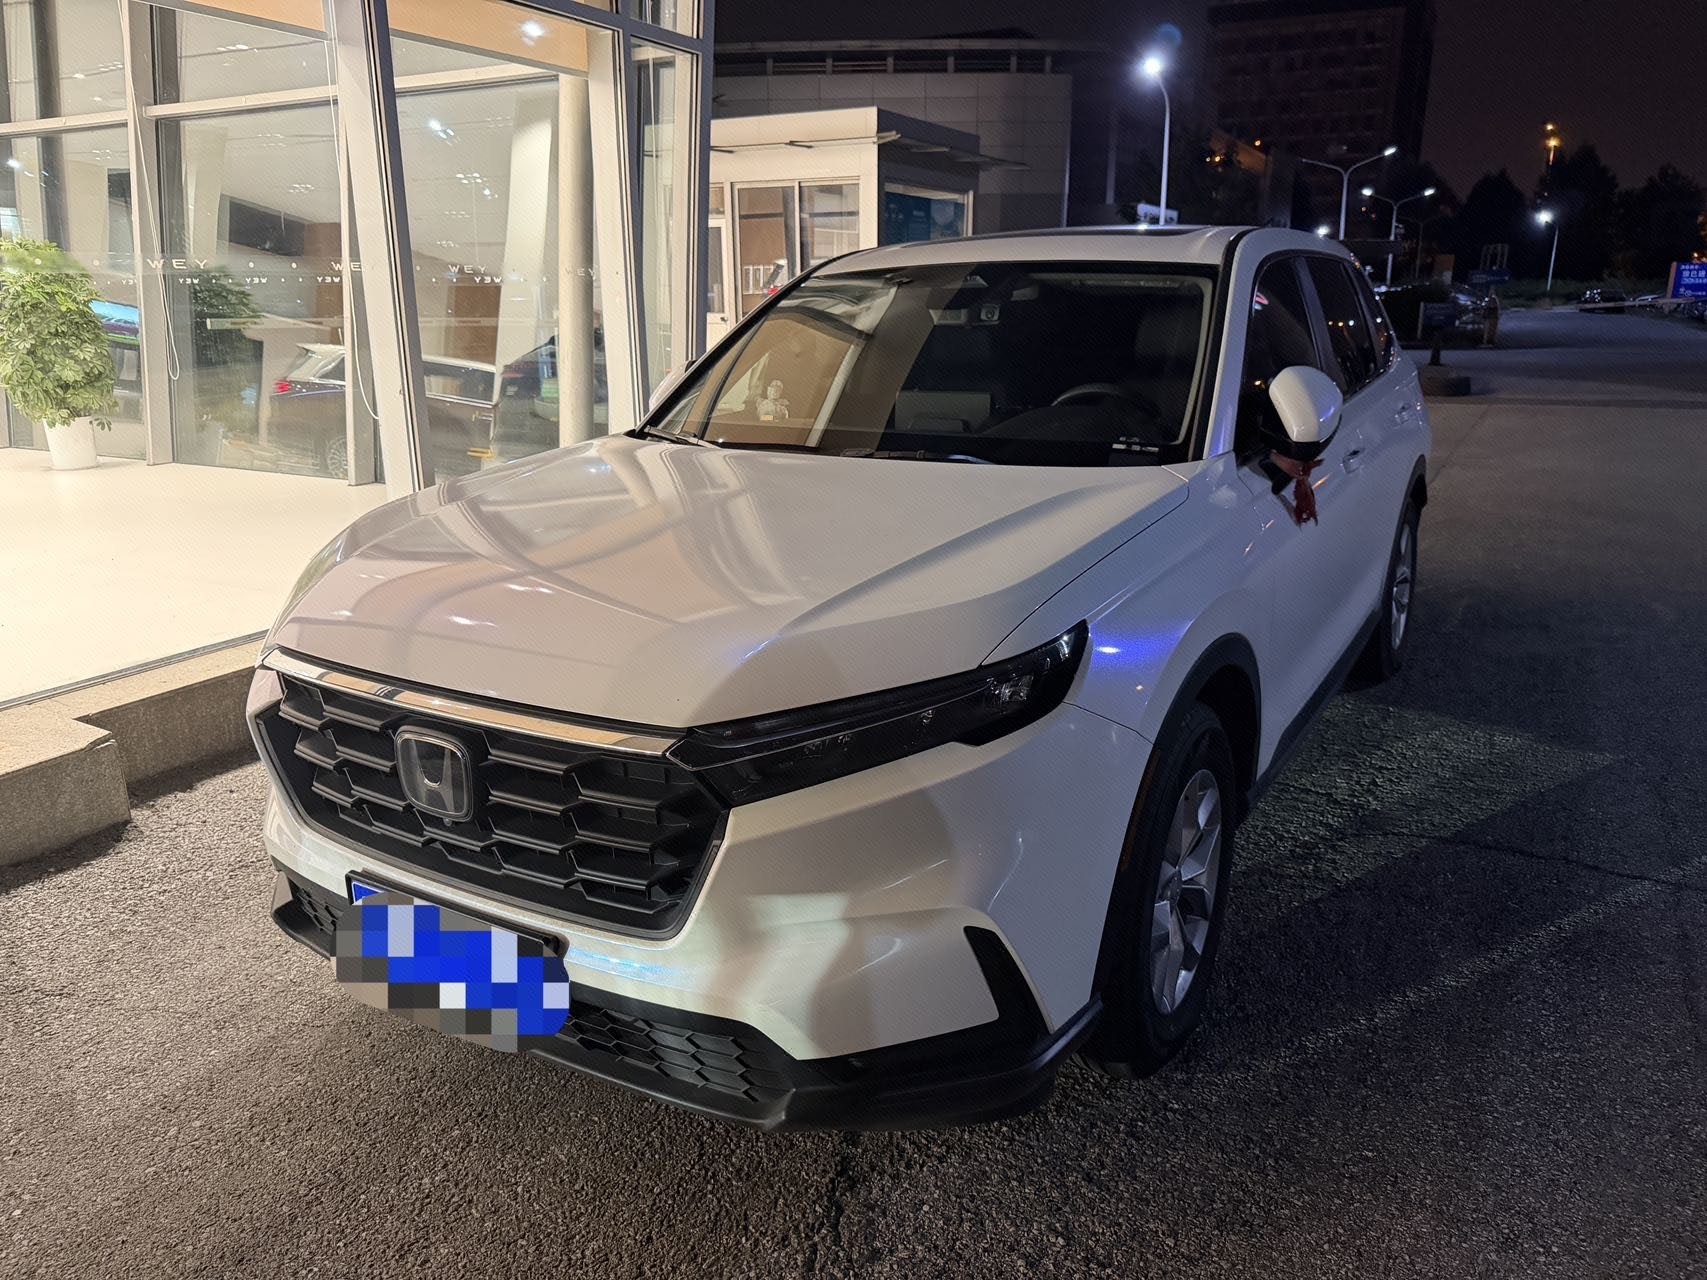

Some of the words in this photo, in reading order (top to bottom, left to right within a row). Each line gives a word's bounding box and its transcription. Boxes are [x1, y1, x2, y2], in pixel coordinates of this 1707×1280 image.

[147, 258, 208, 270] WEY
[330, 261, 364, 272] WE
[448, 264, 487, 274] WEY
